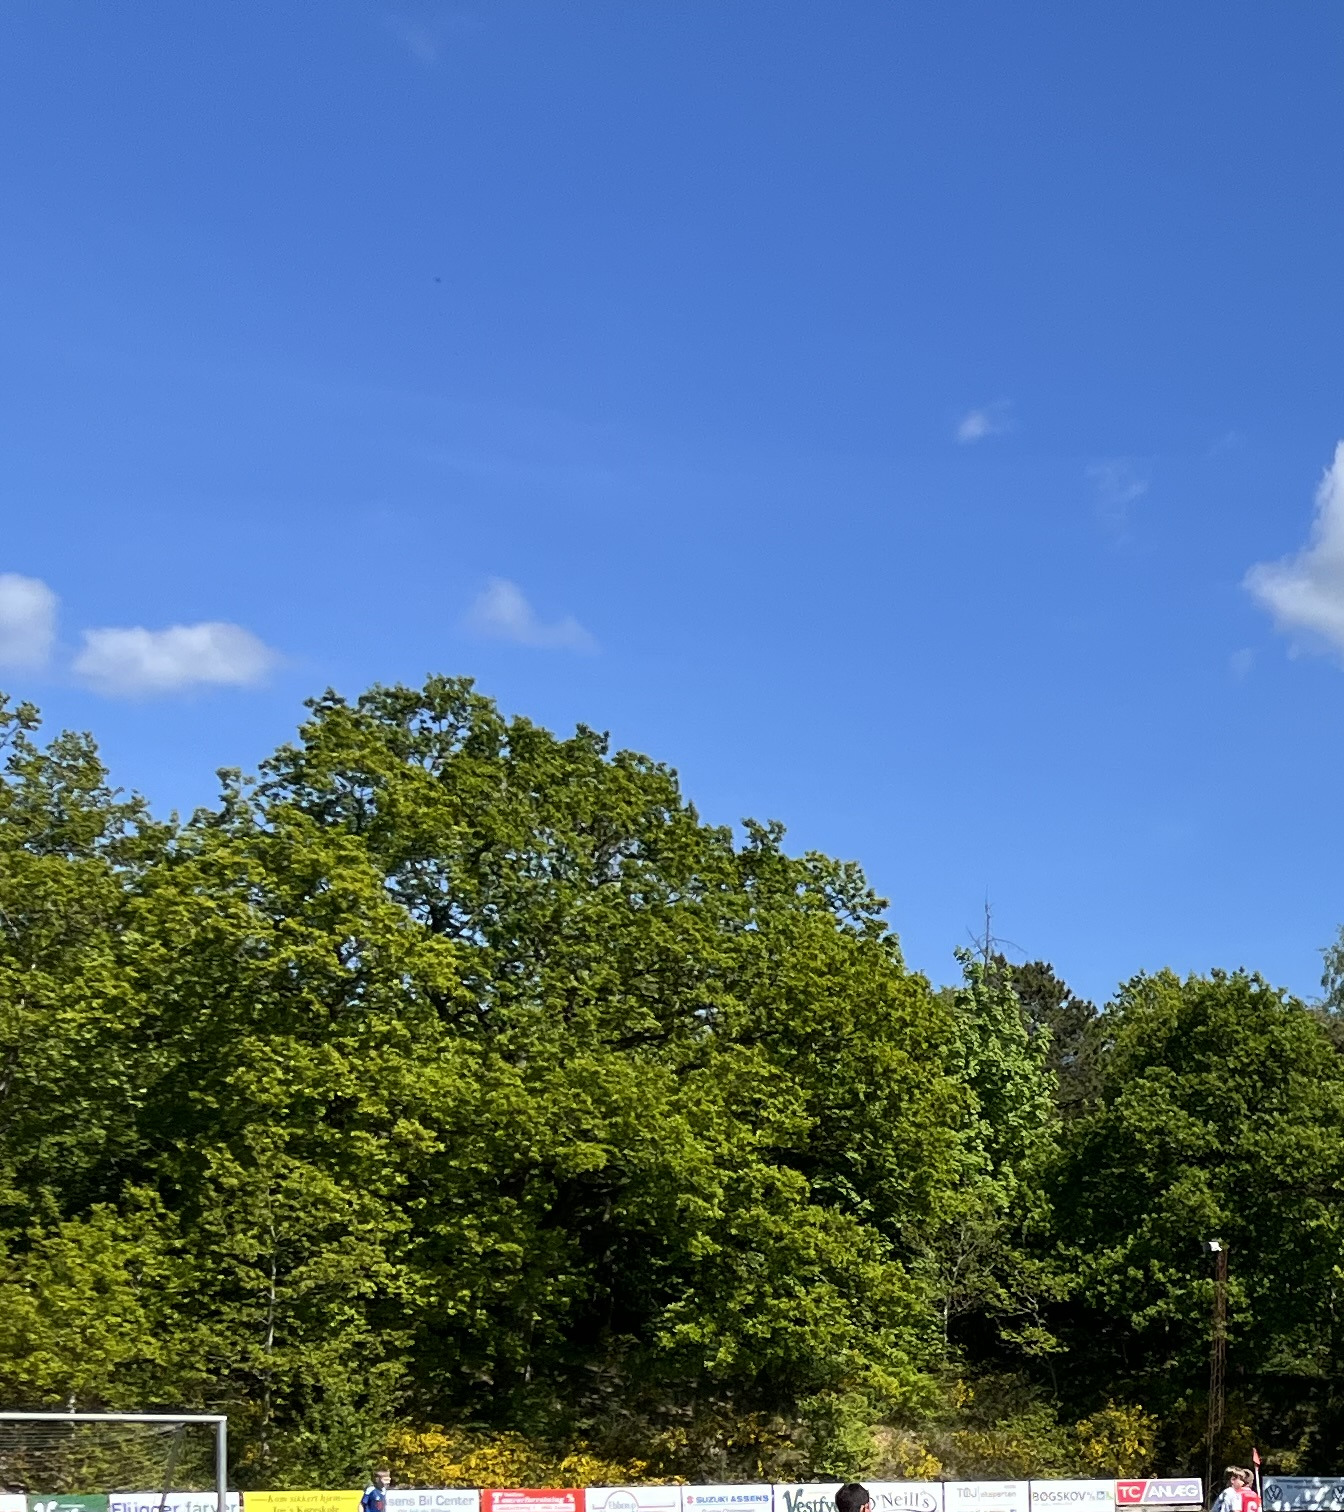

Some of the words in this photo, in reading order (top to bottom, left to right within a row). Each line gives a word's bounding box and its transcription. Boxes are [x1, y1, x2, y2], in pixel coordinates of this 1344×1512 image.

[1119, 1485, 1141, 1499] TC
[1148, 1484, 1199, 1498] ANLÆG
[418, 1495, 433, 1506] Bil
[435, 1494, 475, 1506] Center
[695, 1496, 729, 1504] SUZUKI
[730, 1495, 770, 1503] ASSENS
